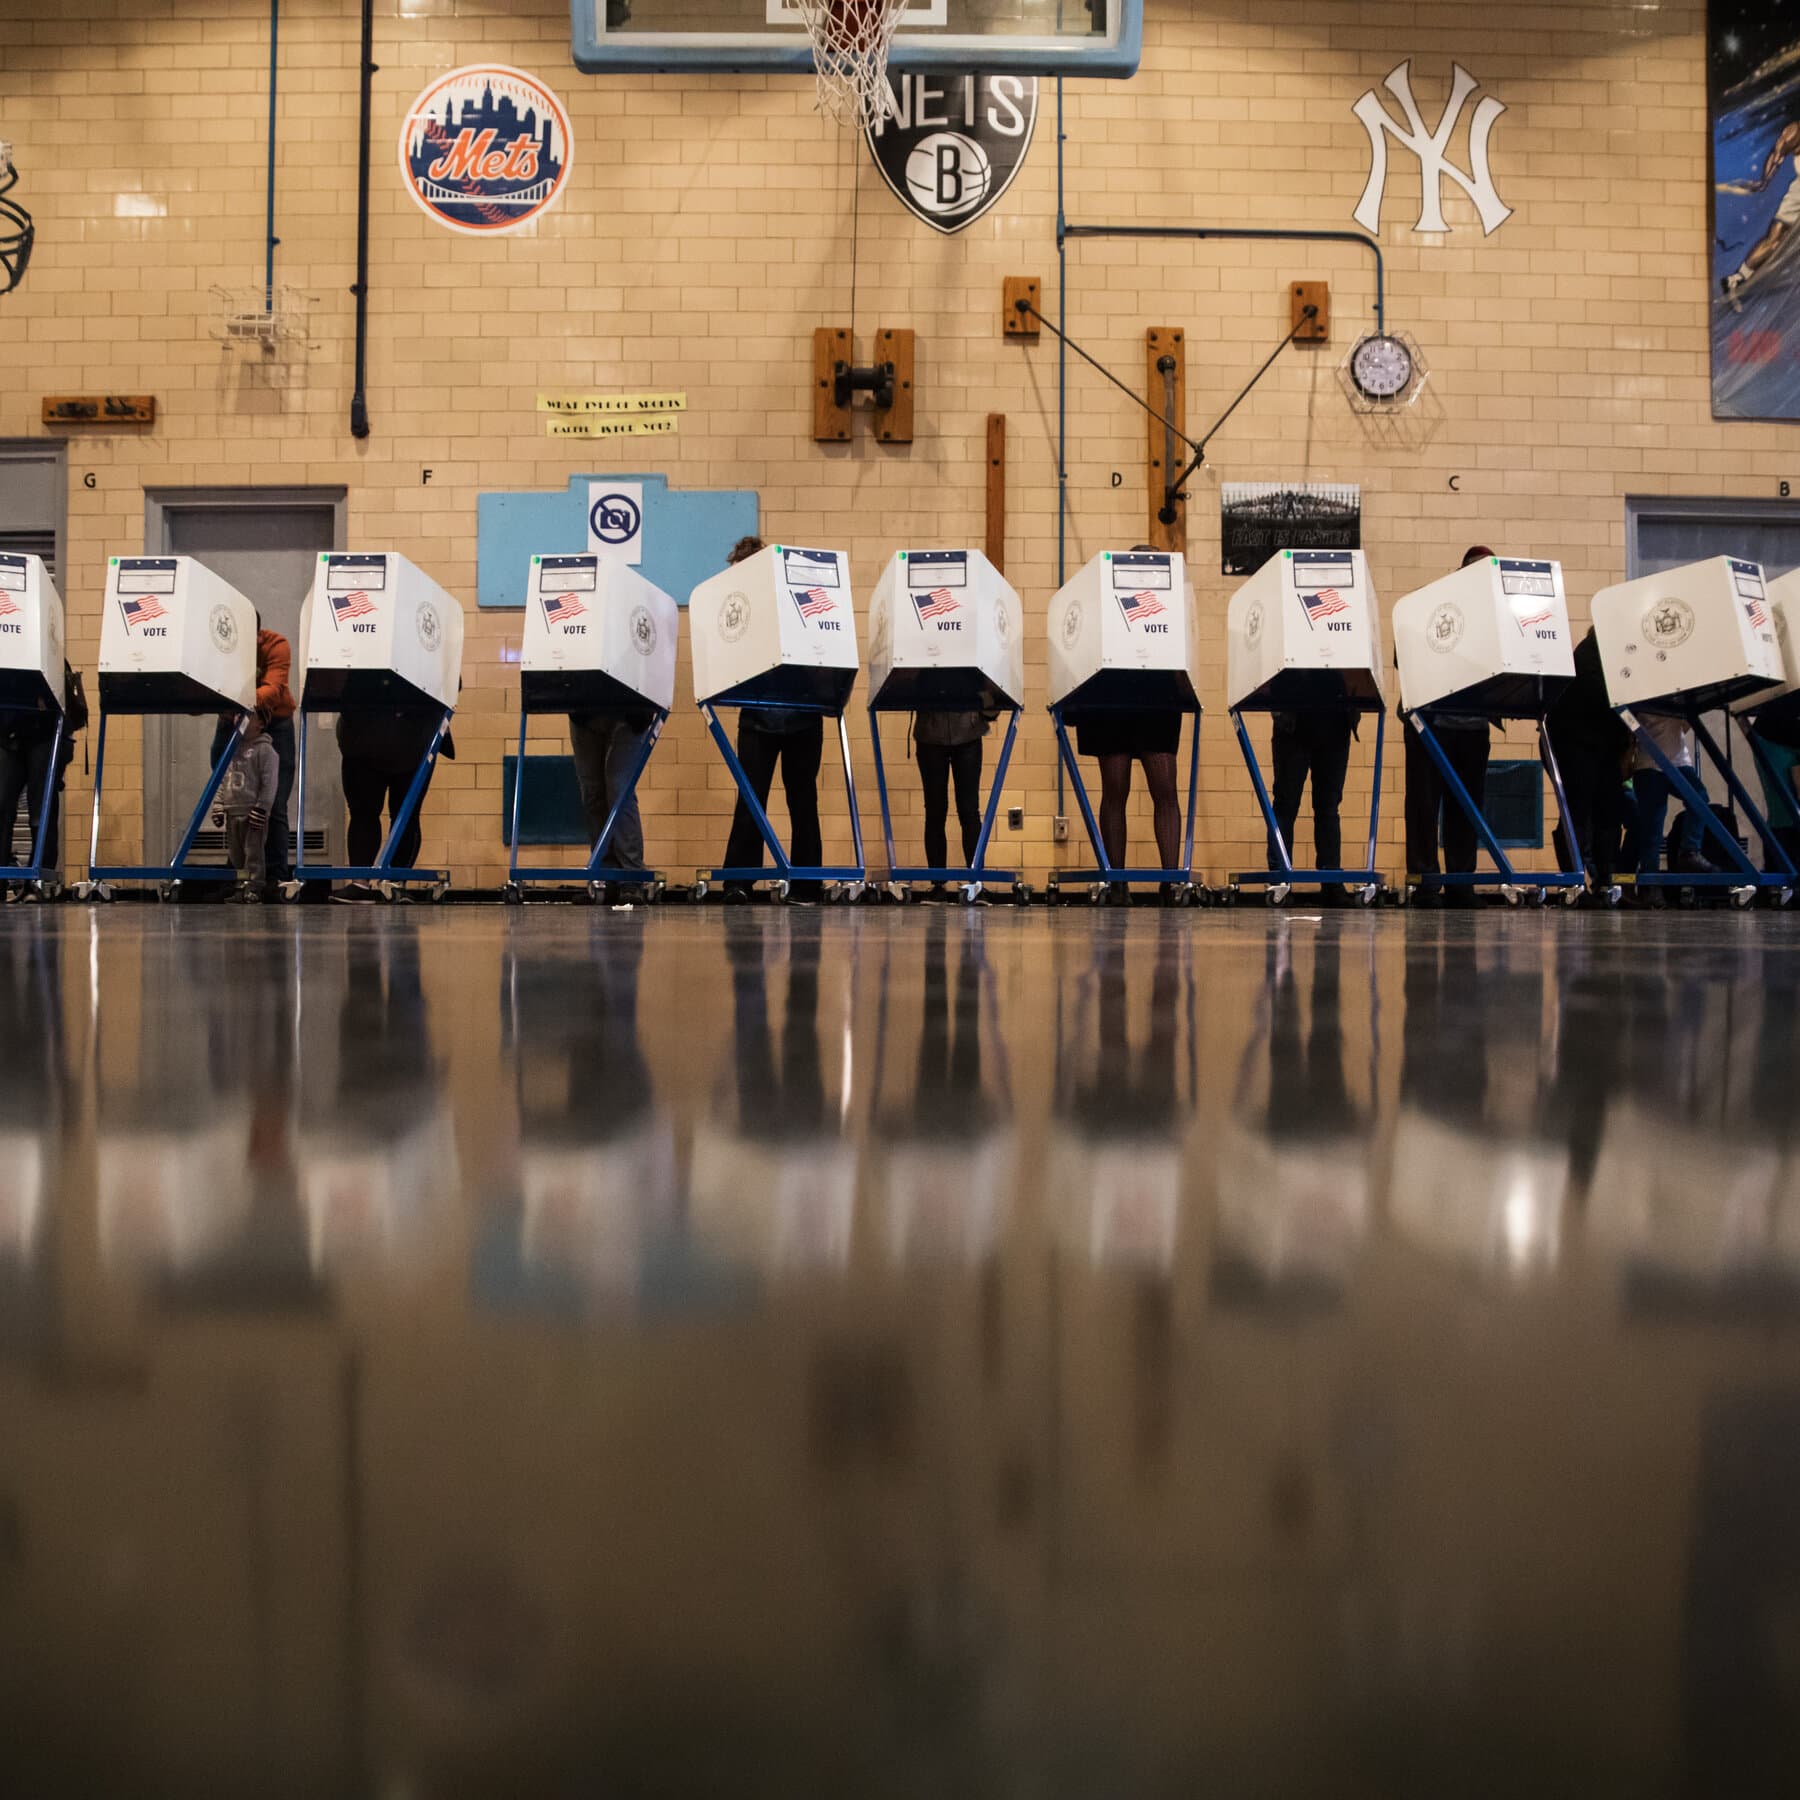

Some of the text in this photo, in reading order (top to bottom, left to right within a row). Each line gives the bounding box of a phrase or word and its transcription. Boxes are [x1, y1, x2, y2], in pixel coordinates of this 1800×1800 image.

[428, 127, 542, 181] Mets
[1351, 58, 1515, 238] NY
[936, 144, 963, 204] B
[84, 472, 97, 489] G
[422, 470, 433, 485] F
[1111, 472, 1123, 488] D
[1448, 475, 1460, 492] C
[1779, 480, 1791, 497] B
[143, 627, 168, 637] VOTE
[352, 623, 377, 633] VOTE
[563, 625, 587, 634] VOTE
[818, 621, 841, 631] VOTE
[937, 621, 962, 631] VOTE
[1144, 624, 1169, 633] VOTE
[1327, 622, 1352, 632] VOTE
[1535, 630, 1557, 640] VOTE
